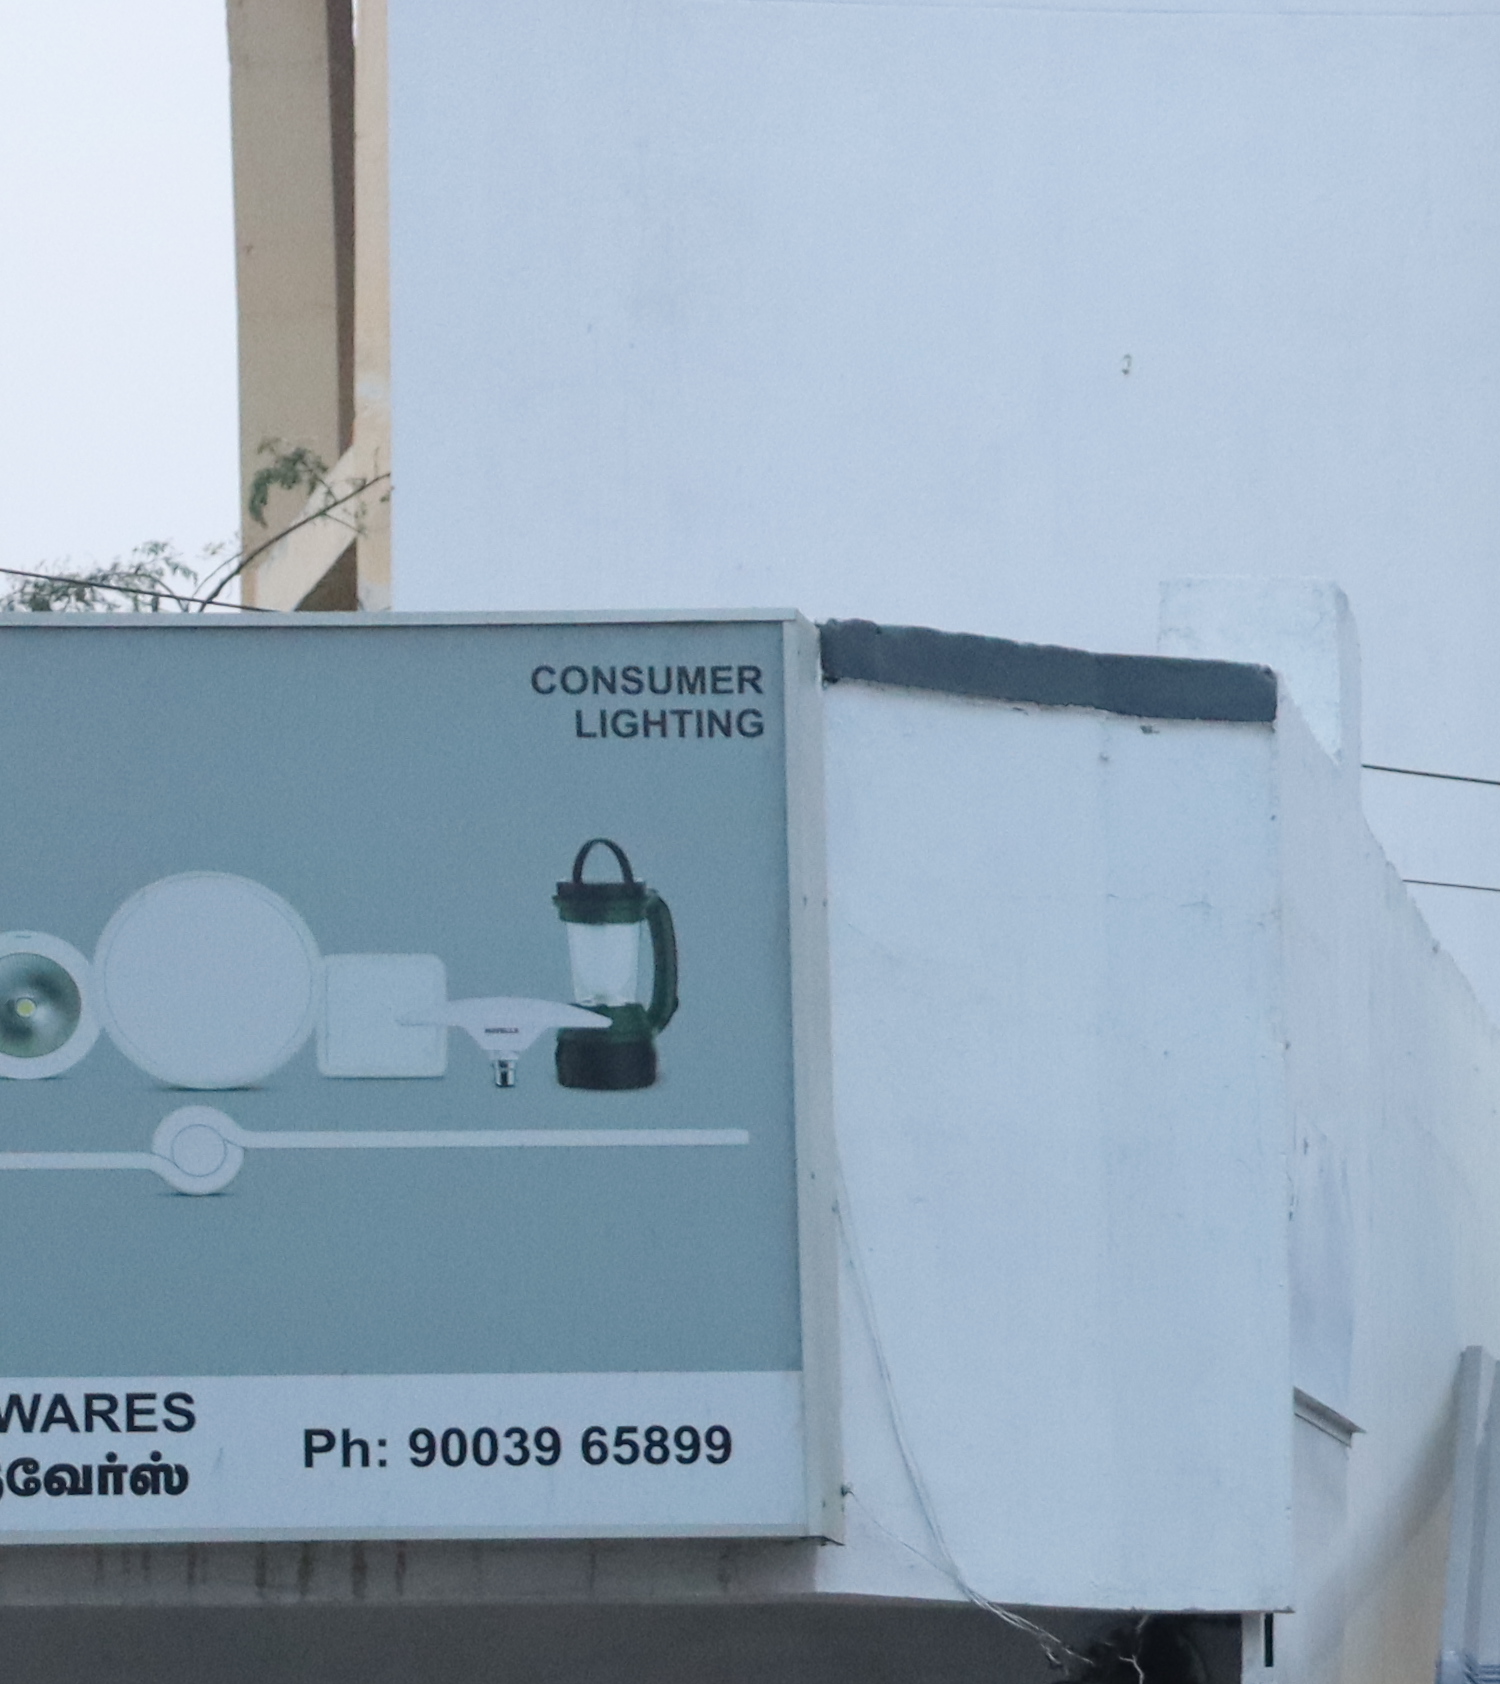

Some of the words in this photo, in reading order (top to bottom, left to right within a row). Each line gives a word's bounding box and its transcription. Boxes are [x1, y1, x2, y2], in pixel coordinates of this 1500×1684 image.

[531, 665, 763, 695] CONSUMER
[576, 709, 764, 738] LIGHTING
[305, 1429, 386, 1468] Ph:
[409, 1427, 561, 1467] 90039
[582, 1425, 731, 1465] 65899
[0, 1451, 190, 1500] வேர்ஸ்
